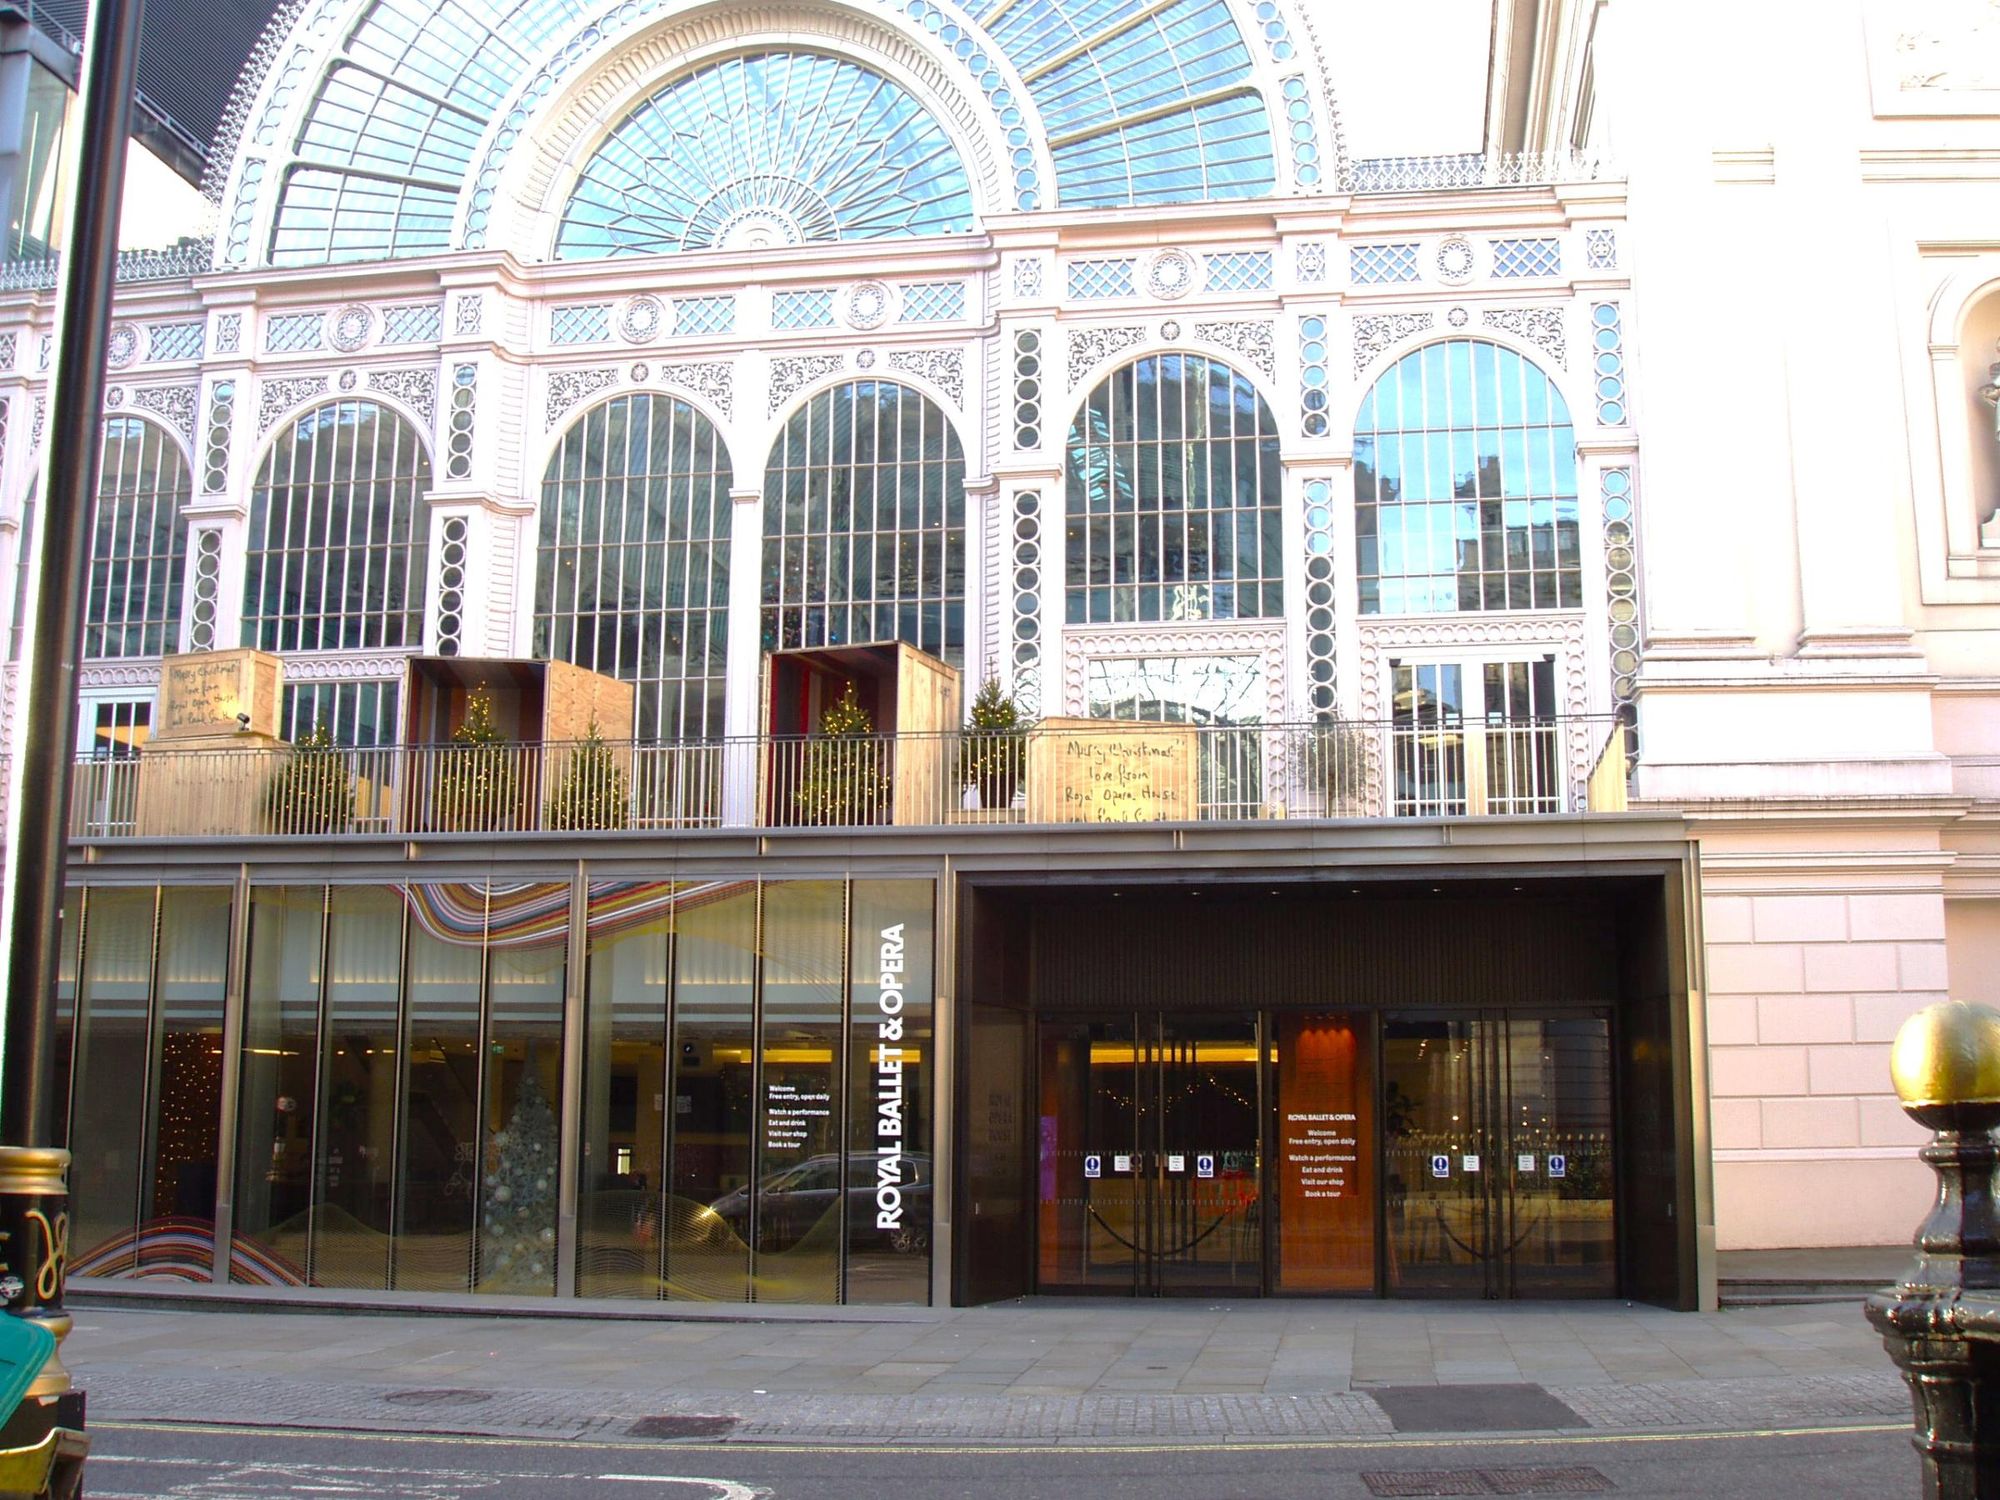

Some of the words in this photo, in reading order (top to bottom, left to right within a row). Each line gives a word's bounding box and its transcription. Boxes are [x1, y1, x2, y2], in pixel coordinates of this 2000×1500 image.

[879, 922, 905, 1015] OPERA
[878, 1016, 904, 1041] &
[878, 1043, 903, 1136] BALLET
[816, 1093, 830, 1101] daily
[768, 1108, 787, 1116] Watch
[793, 1108, 830, 1117] performance
[793, 1130, 808, 1138] shop
[1340, 1138, 1356, 1146] daily
[1314, 1154, 1356, 1162] performance
[877, 1141, 904, 1229] ROYAL
[1328, 1179, 1344, 1187] shop
